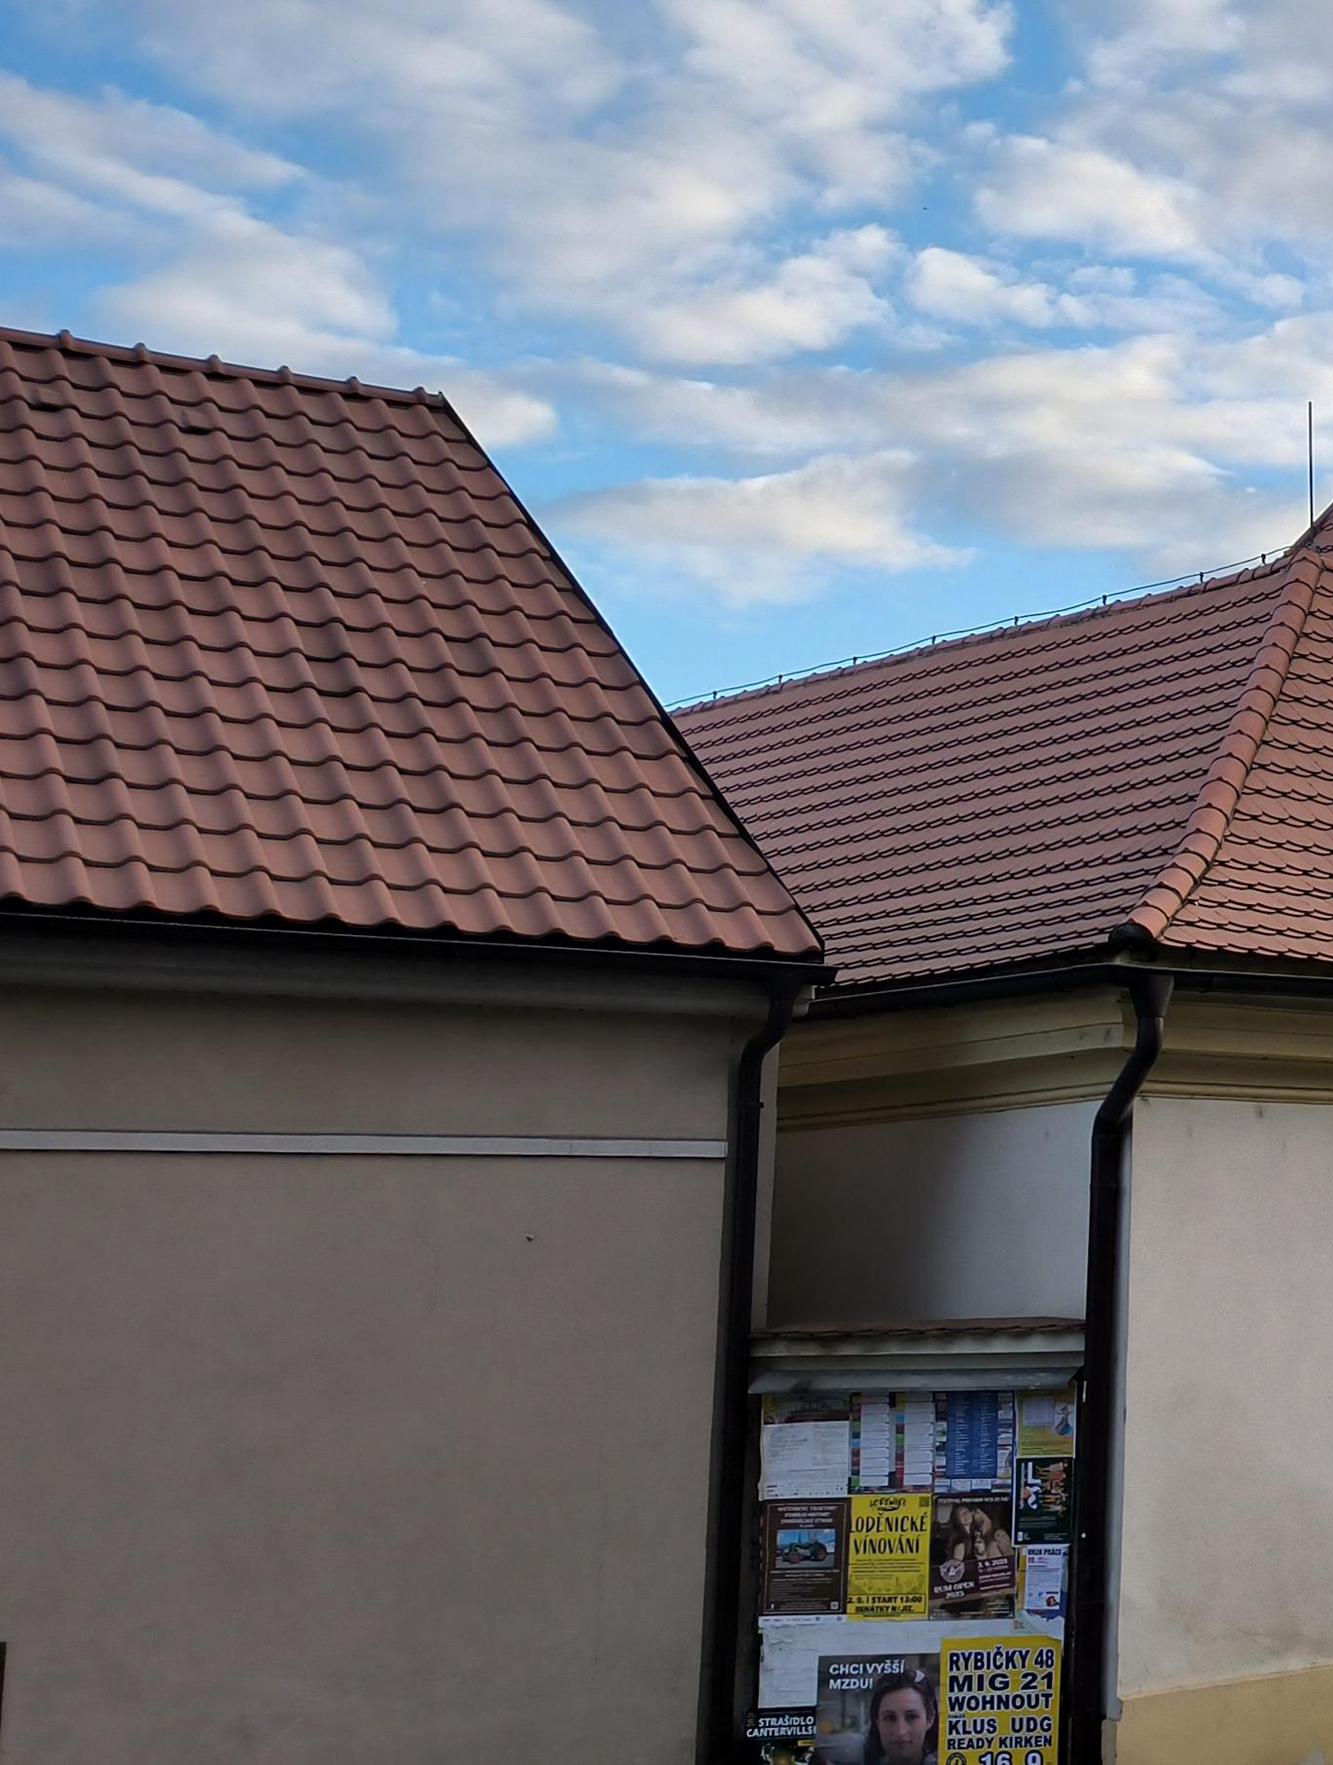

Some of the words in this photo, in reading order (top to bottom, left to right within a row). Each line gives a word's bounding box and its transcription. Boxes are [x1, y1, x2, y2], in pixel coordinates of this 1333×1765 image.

[854, 1535, 920, 1554] VÍNOVÁNÍ
[829, 1663, 863, 1675] CHCI
[866, 1659, 905, 1674] VYŠŠÍ
[949, 1646, 1030, 1672] RYBIČKY
[1034, 1648, 1055, 1669] 48
[829, 1678, 873, 1690] MZDU!
[949, 1673, 1010, 1692] MIG
[1020, 1671, 1053, 1691] 21
[948, 1693, 1053, 1712] WOHNOUT
[758, 1715, 814, 1727] STRAŠIDLO
[948, 1718, 997, 1735] KLUS
[1011, 1716, 1052, 1733] UDG
[947, 1737, 994, 1750] READY
[999, 1735, 1052, 1748] KIRKEN
